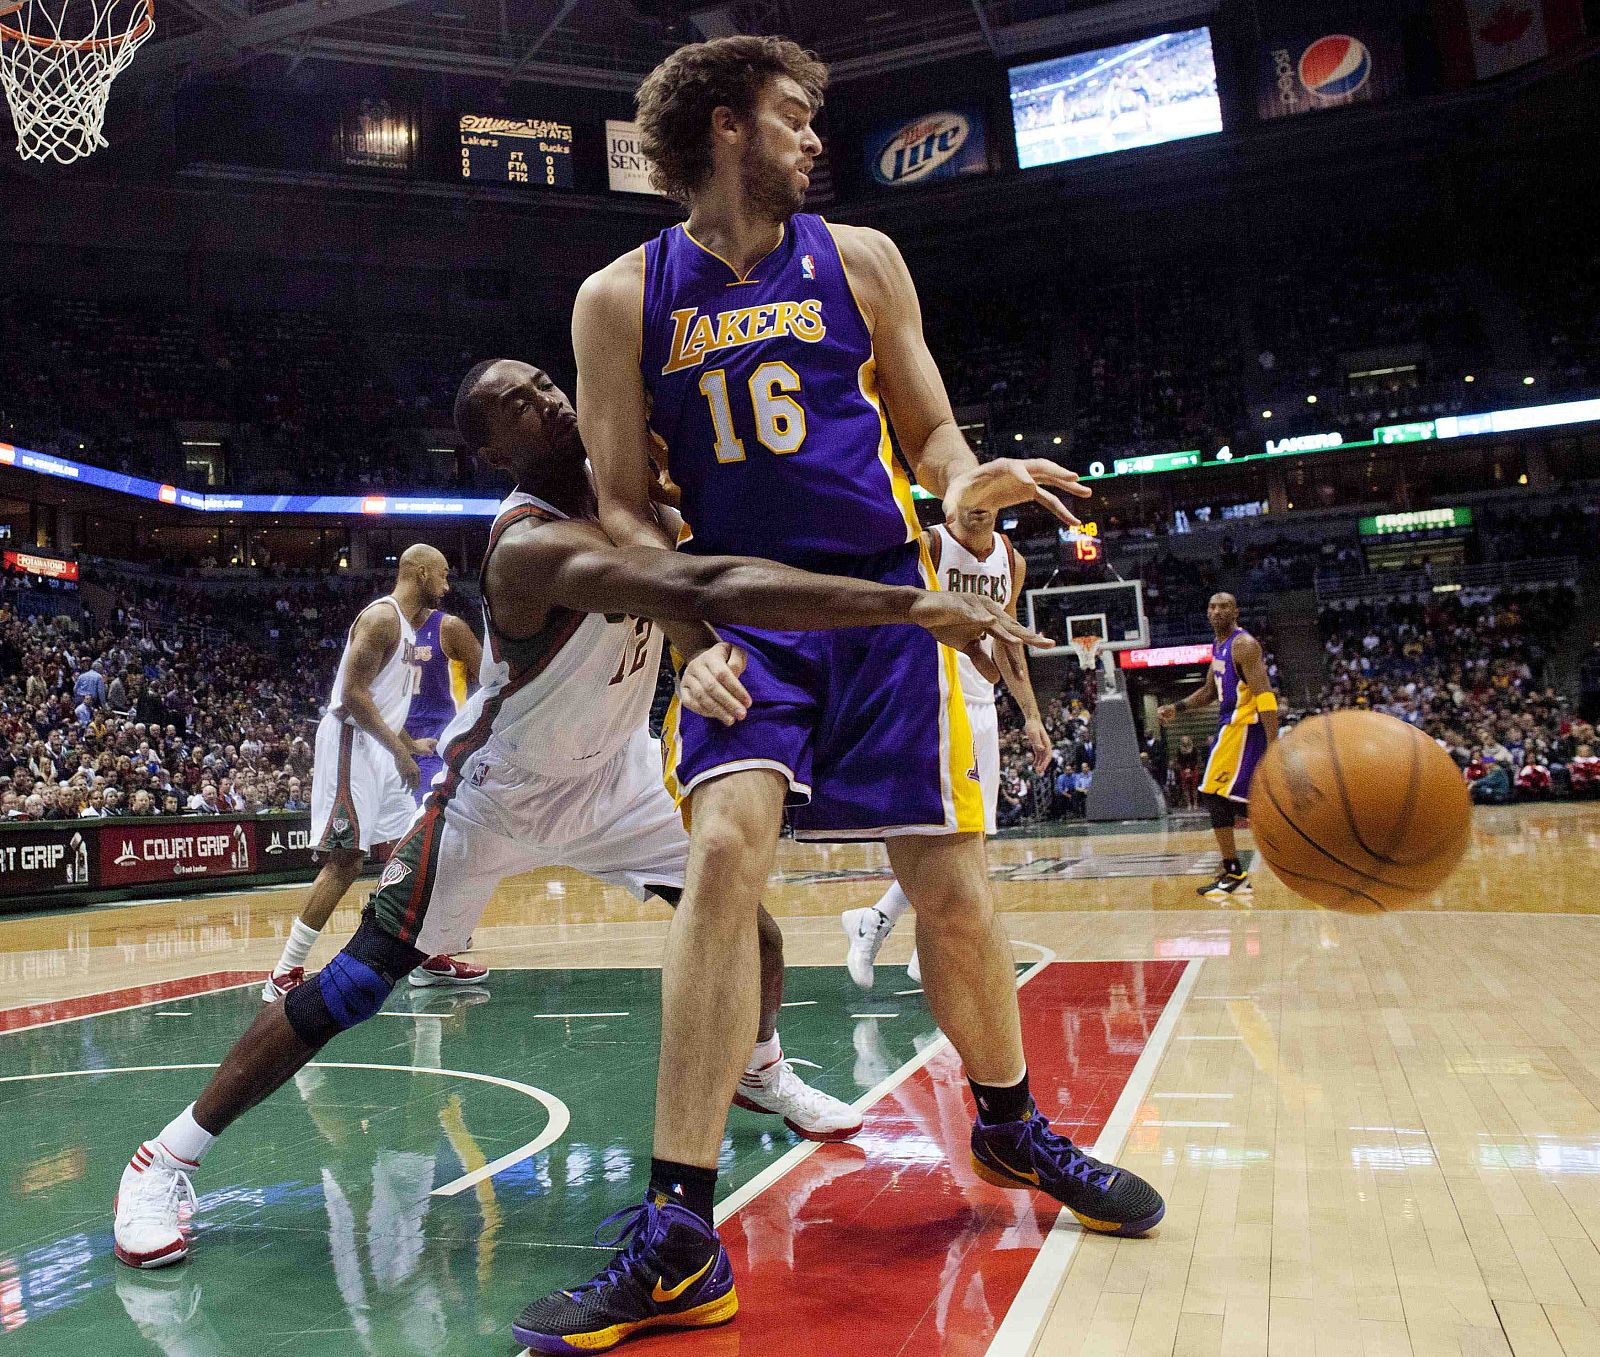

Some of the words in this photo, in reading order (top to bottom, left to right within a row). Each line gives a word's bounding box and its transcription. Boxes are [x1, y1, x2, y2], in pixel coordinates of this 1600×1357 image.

[527, 119, 558, 130] TEAM
[461, 135, 498, 147] Lakers
[540, 142, 570, 154] Bucks
[610, 139, 641, 155] JOU
[893, 126, 960, 180] Lite
[461, 148, 469, 157] 0
[511, 152, 523, 161] FT
[546, 156, 554, 165] 0
[462, 158, 470, 167] 0
[508, 162, 528, 172] FTA
[547, 166, 554, 175] 0
[463, 168, 470, 177] 0
[547, 175, 555, 185] 0
[661, 299, 826, 376] LAKERS
[699, 360, 807, 464] 16
[1266, 432, 1343, 454] LAKERS
[1216, 445, 1233, 463] 4
[1076, 538, 1098, 560] 15
[946, 568, 1007, 604] BUCKS
[143, 837, 194, 861] COURT
[197, 835, 229, 857] GRIP
[288, 830, 311, 849] COU
[21, 844, 64, 870] GRIP
